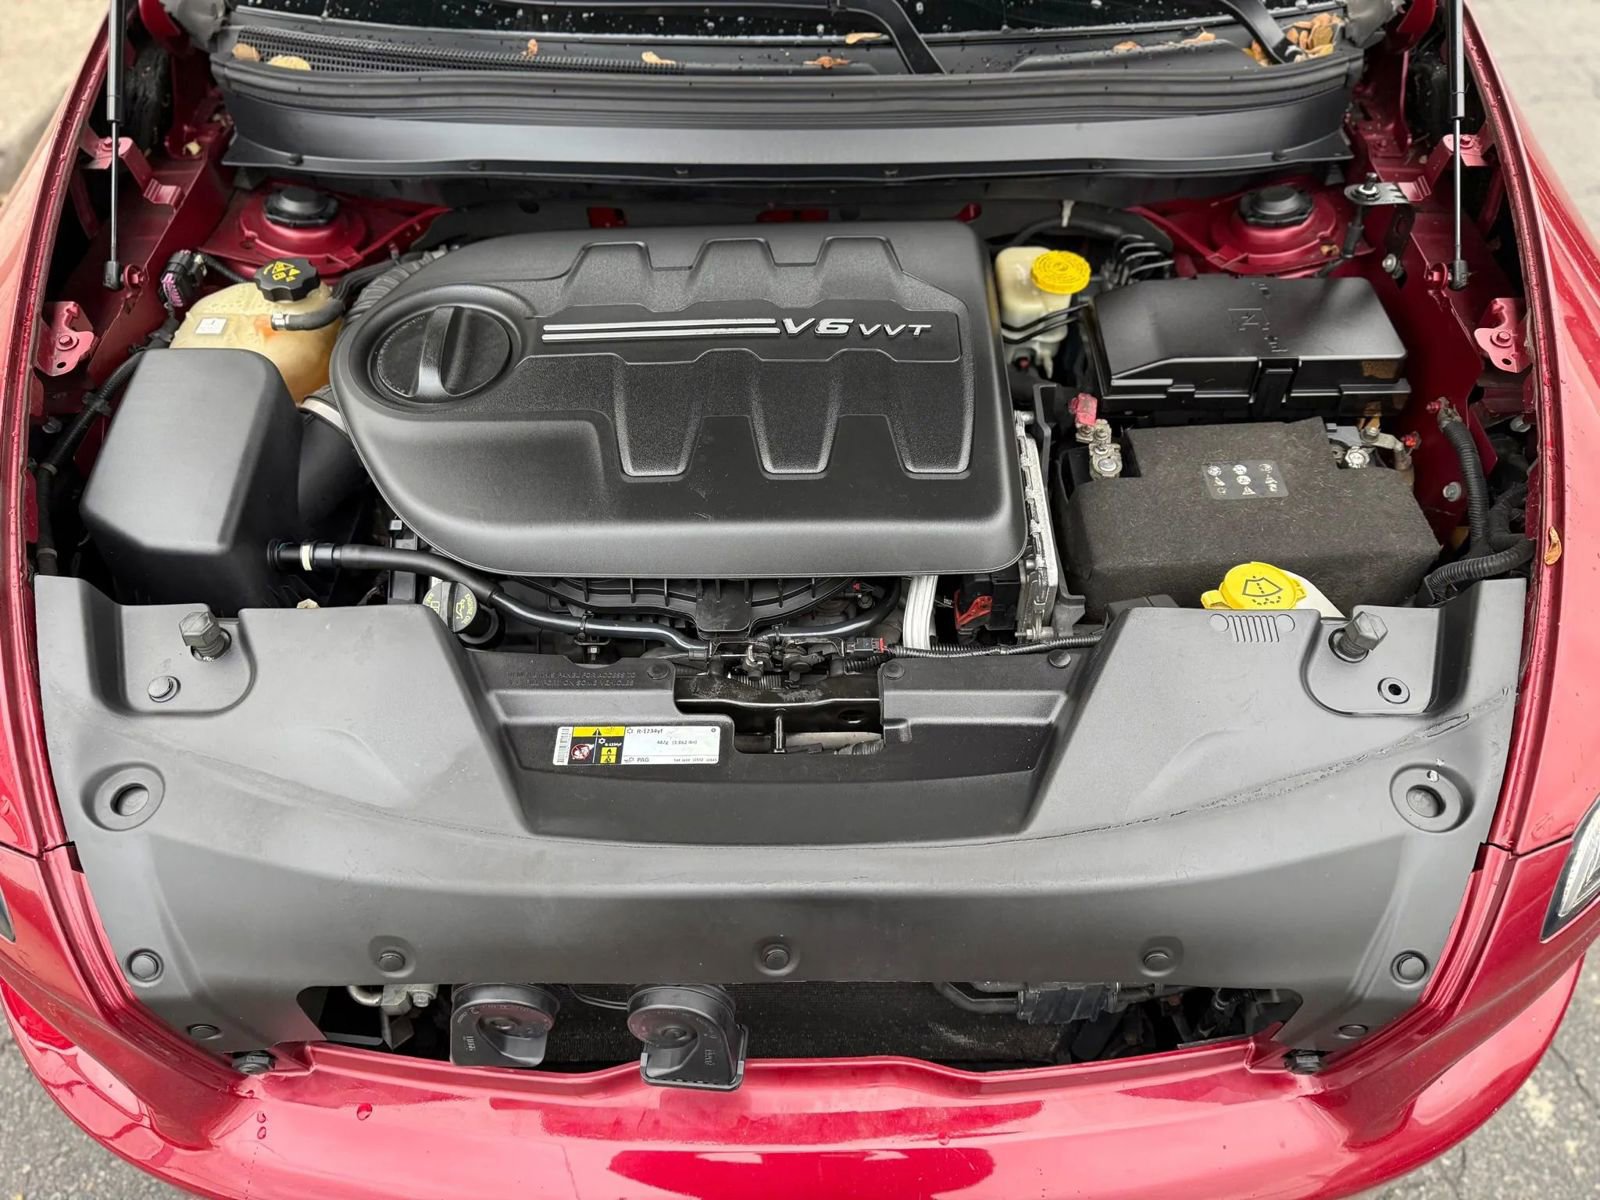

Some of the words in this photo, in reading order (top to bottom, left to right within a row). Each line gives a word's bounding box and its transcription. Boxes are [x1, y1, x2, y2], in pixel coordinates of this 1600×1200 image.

[782, 318, 854, 337] V6
[858, 323, 932, 337] VVT
[464, 593, 473, 615] ENGINE
[461, 615, 471, 625] OIL
